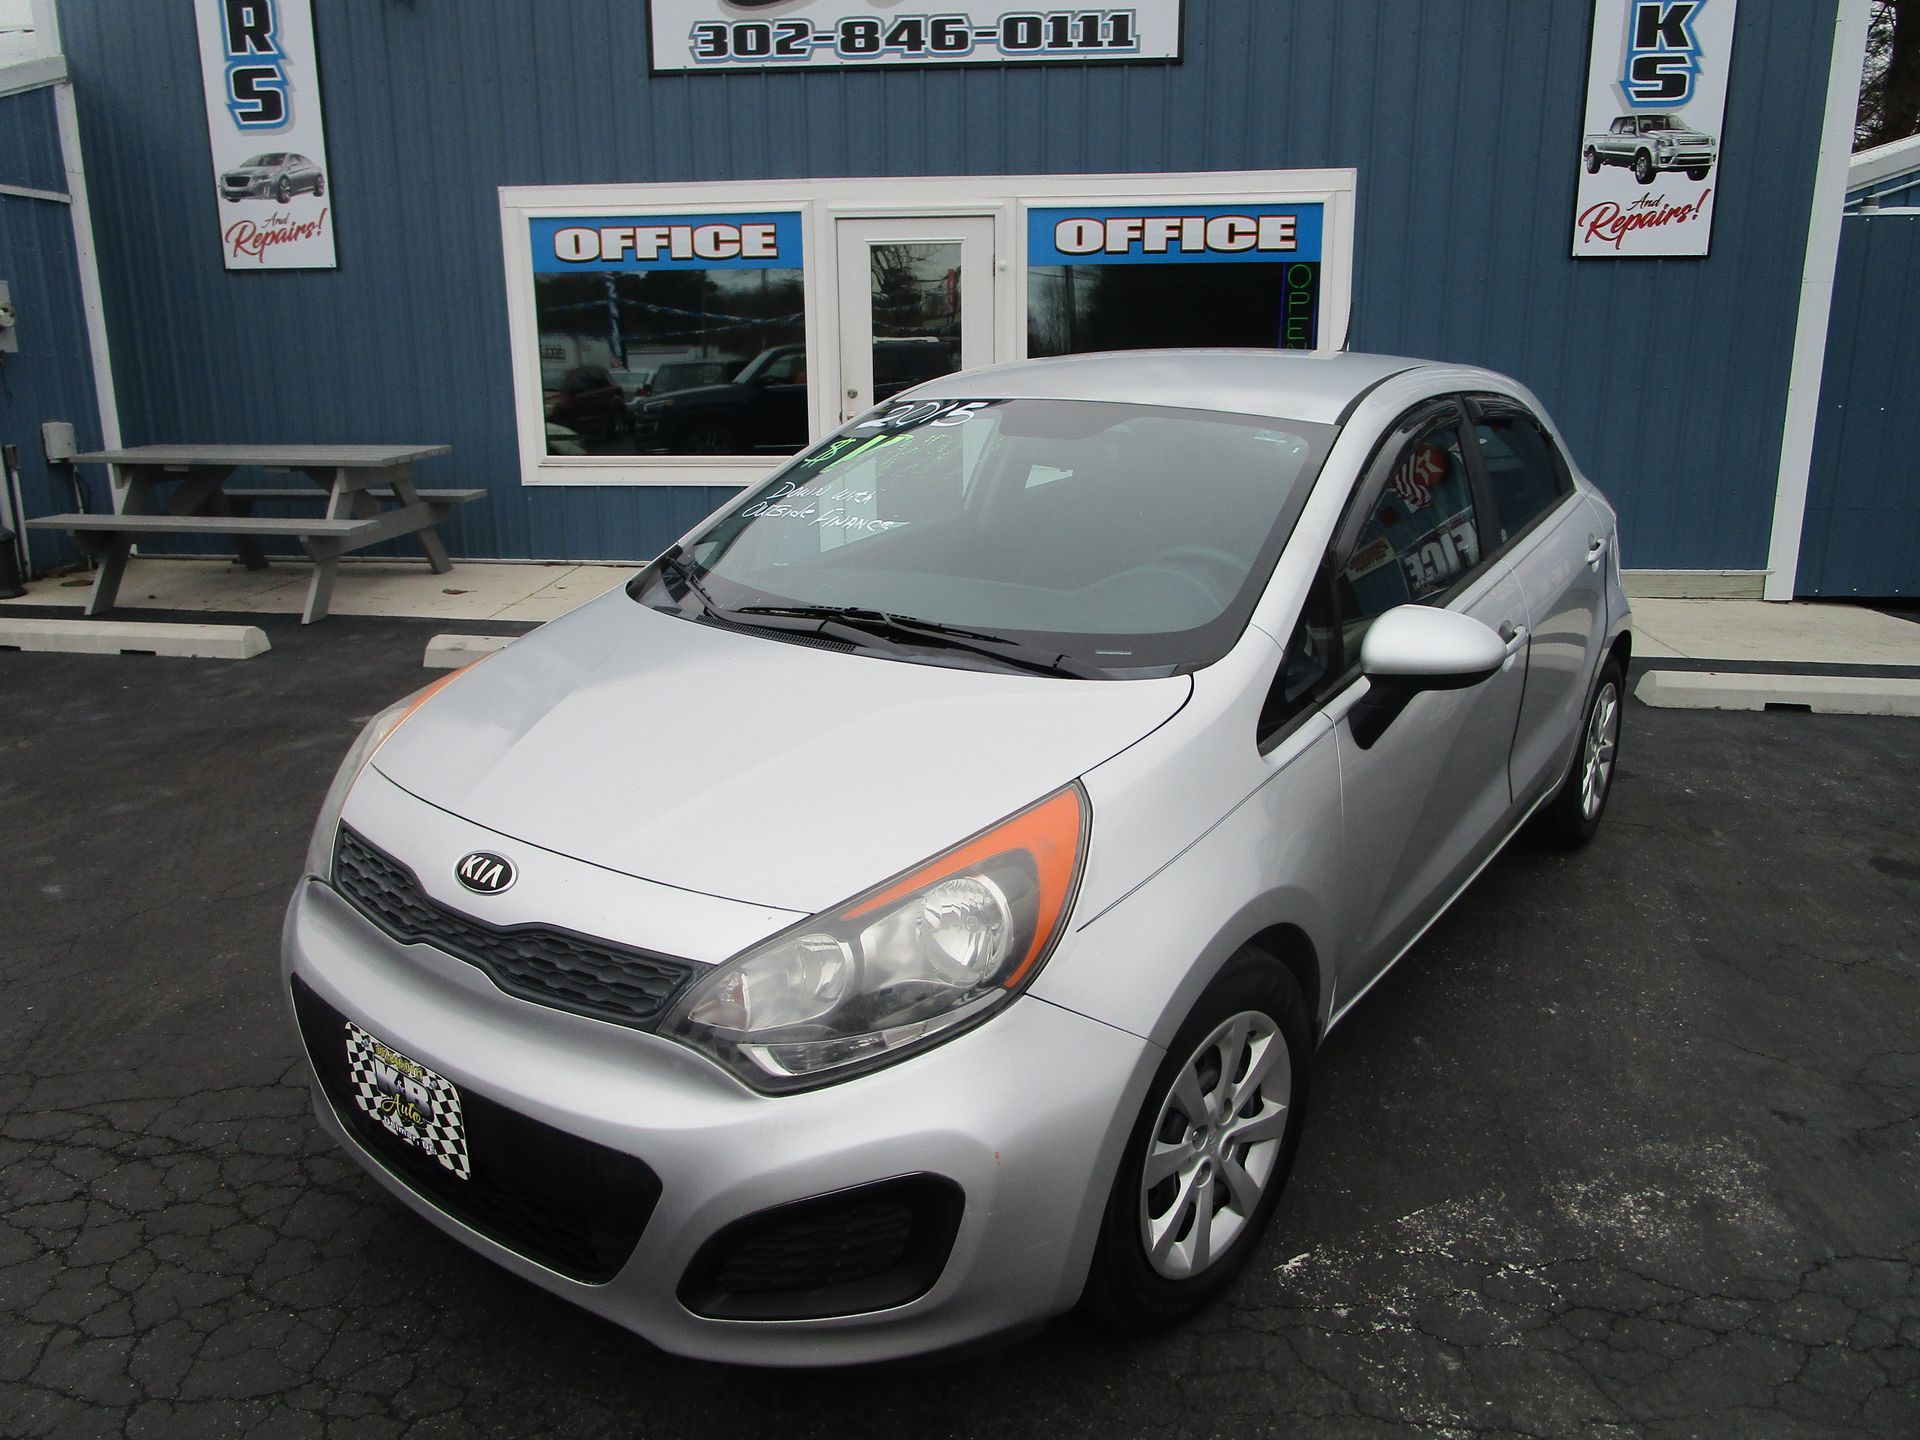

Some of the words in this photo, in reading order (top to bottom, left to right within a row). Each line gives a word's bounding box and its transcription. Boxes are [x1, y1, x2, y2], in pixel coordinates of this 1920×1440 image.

[692, 11, 1138, 60] 302-846-0111
[262, 211, 290, 228] And
[1577, 188, 1711, 250] Repairs!
[1626, 192, 1665, 211] And
[225, 208, 327, 263] Repairs!
[554, 223, 779, 262] OFFICE
[1054, 215, 1297, 254] OFFICE
[1287, 264, 1312, 349] OPE
[856, 401, 990, 431] 2015
[460, 854, 504, 888] KIA
[382, 1093, 424, 1125] Auto
